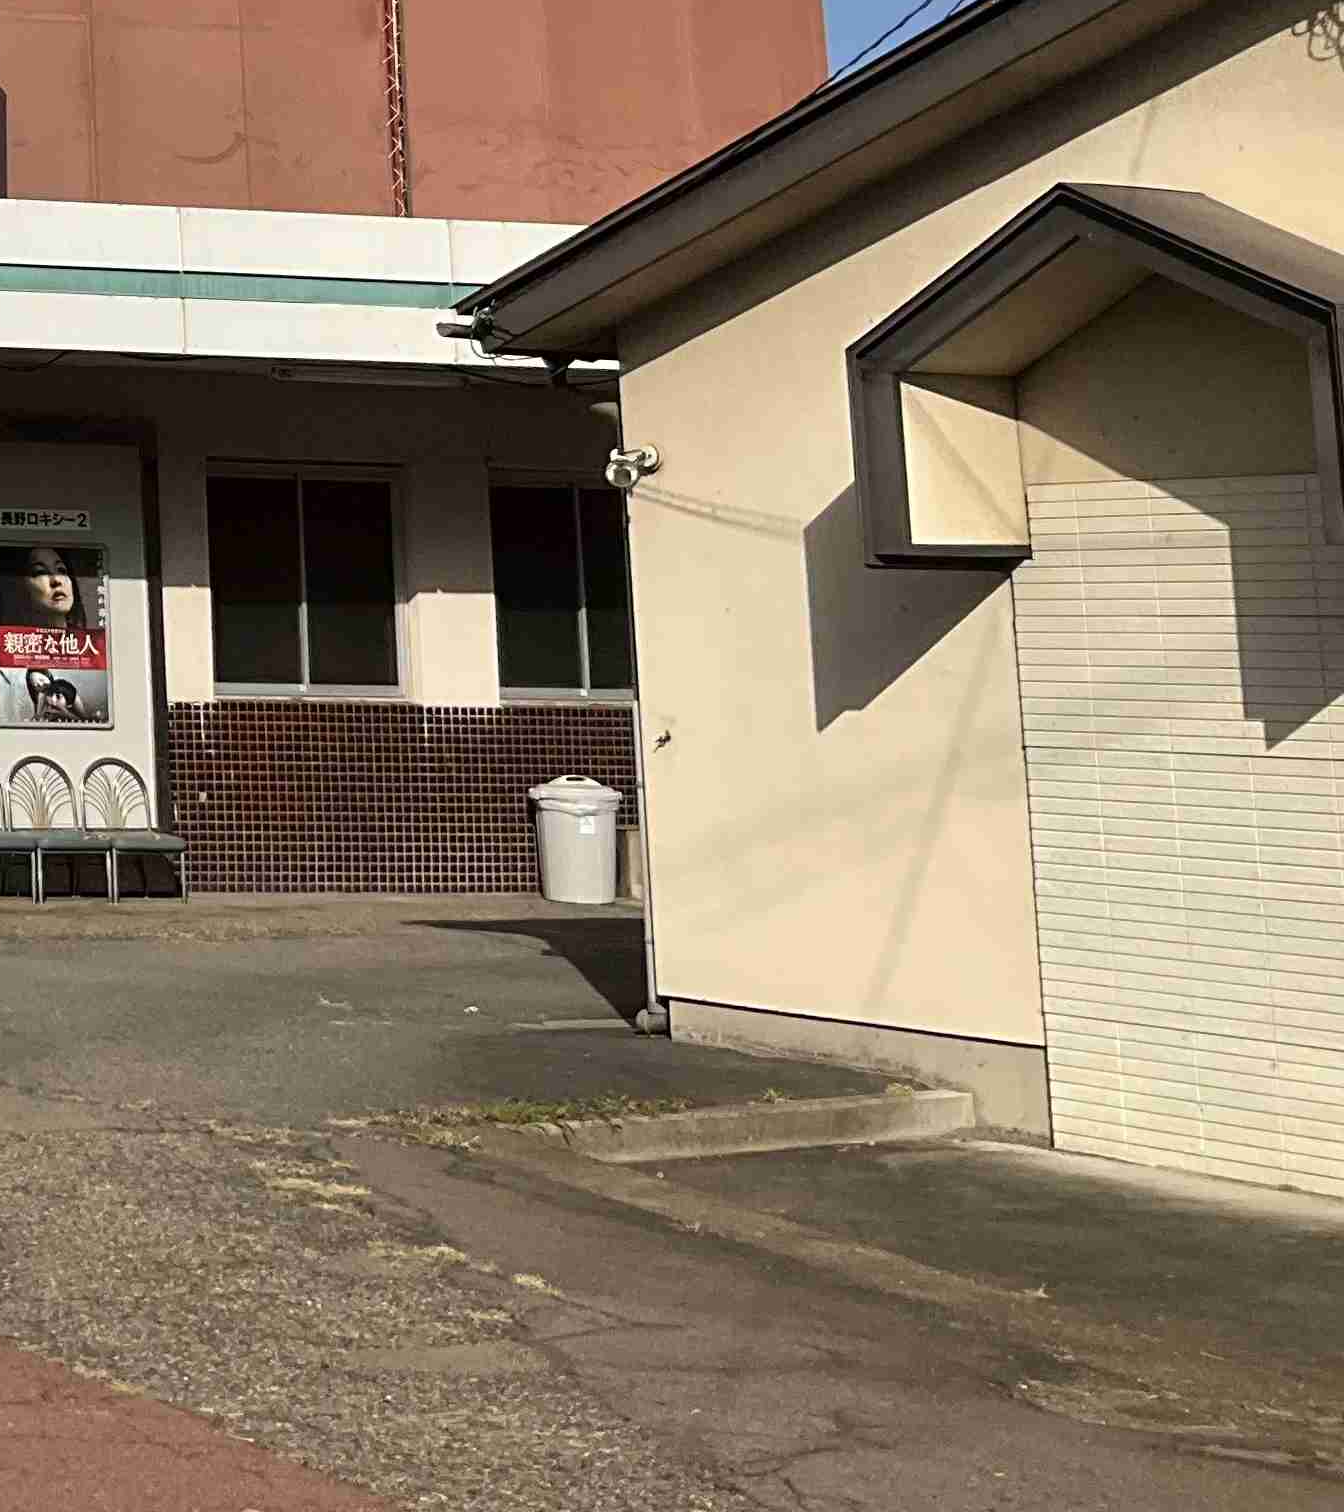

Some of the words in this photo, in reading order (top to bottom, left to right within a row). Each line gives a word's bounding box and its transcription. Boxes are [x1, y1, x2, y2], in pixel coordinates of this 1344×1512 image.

[3, 631, 100, 656] 親密な他人
